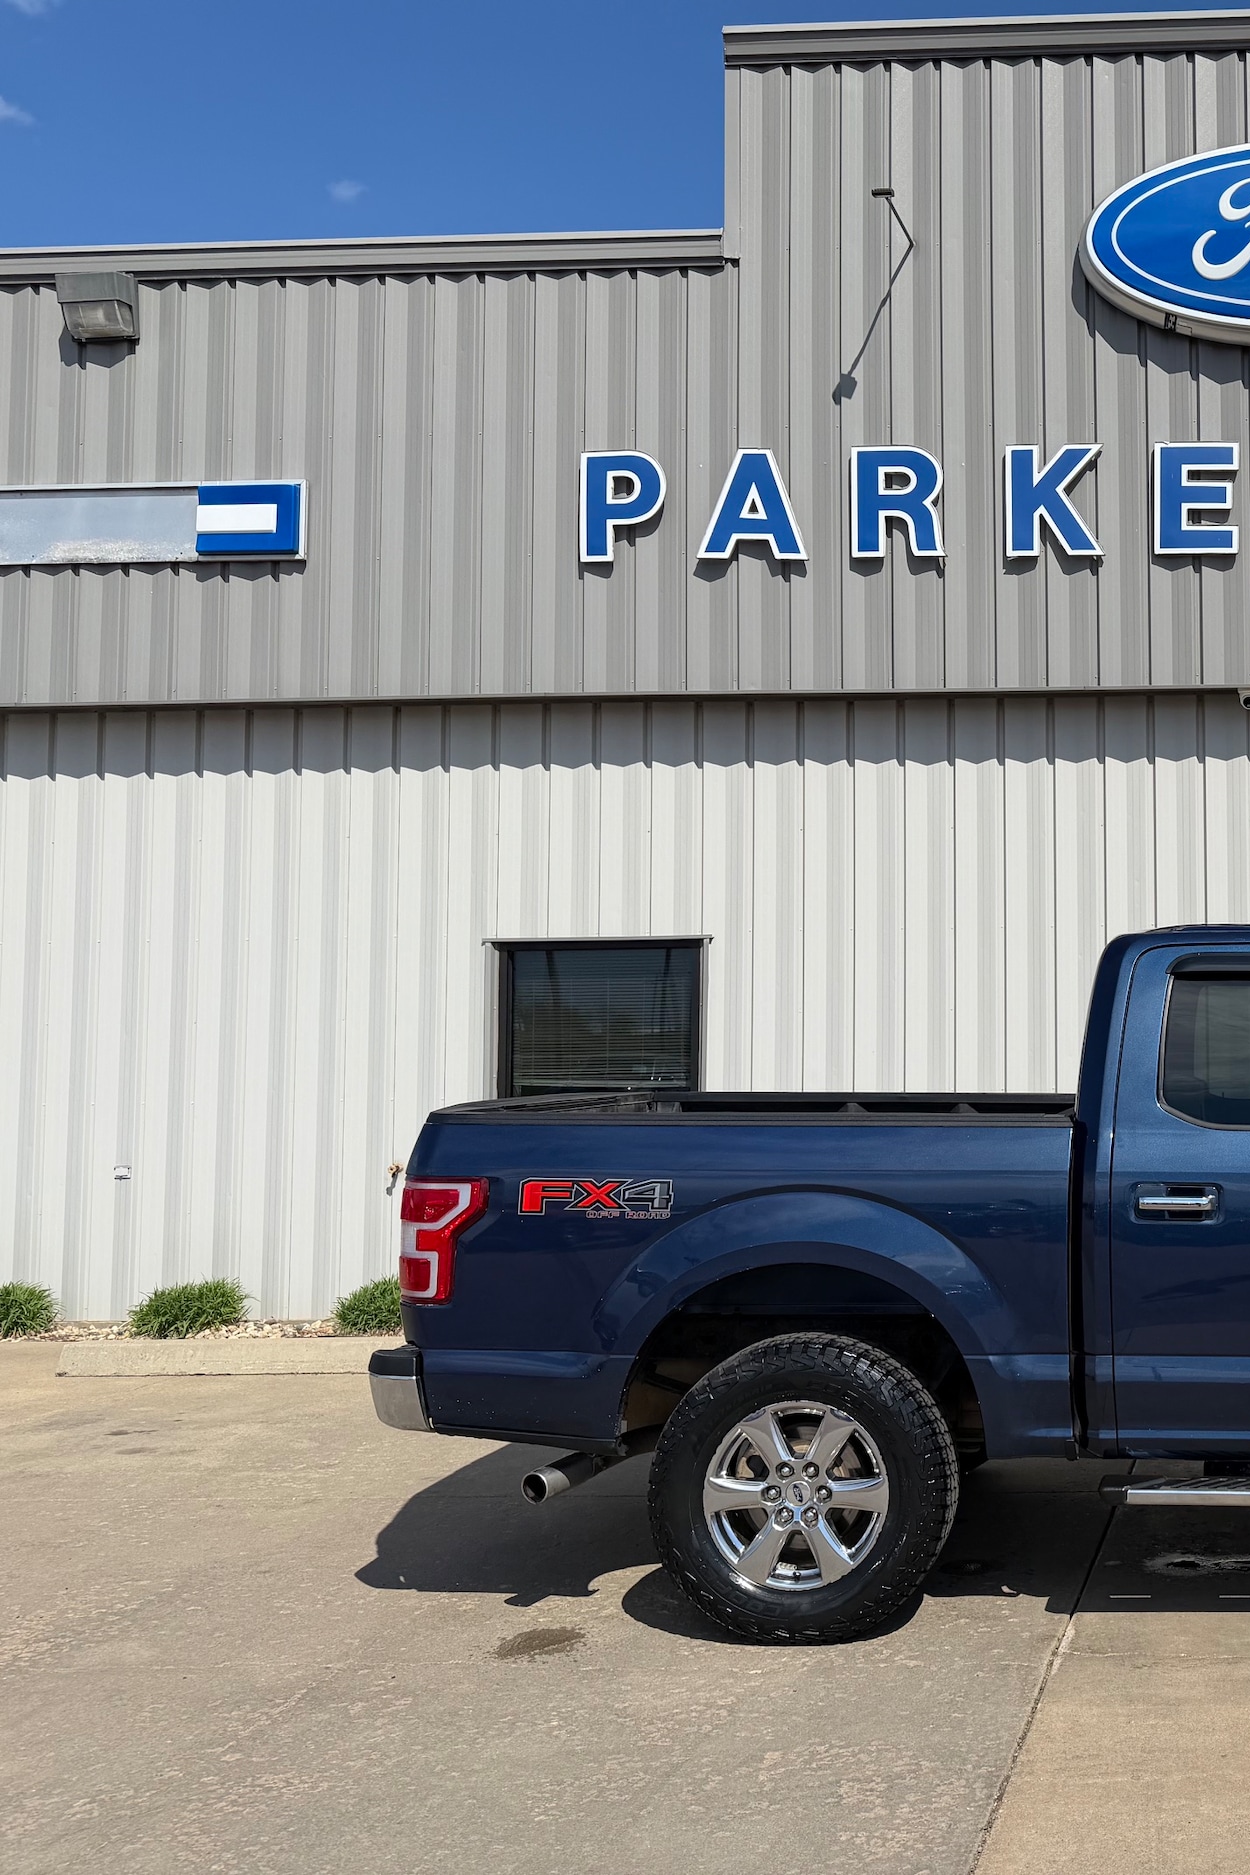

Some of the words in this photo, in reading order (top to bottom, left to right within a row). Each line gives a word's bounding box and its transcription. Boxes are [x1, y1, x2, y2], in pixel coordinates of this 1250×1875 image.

[518, 1177, 673, 1216] FX4
[585, 1210, 621, 1219] OFF
[625, 1210, 671, 1219] ROAD
